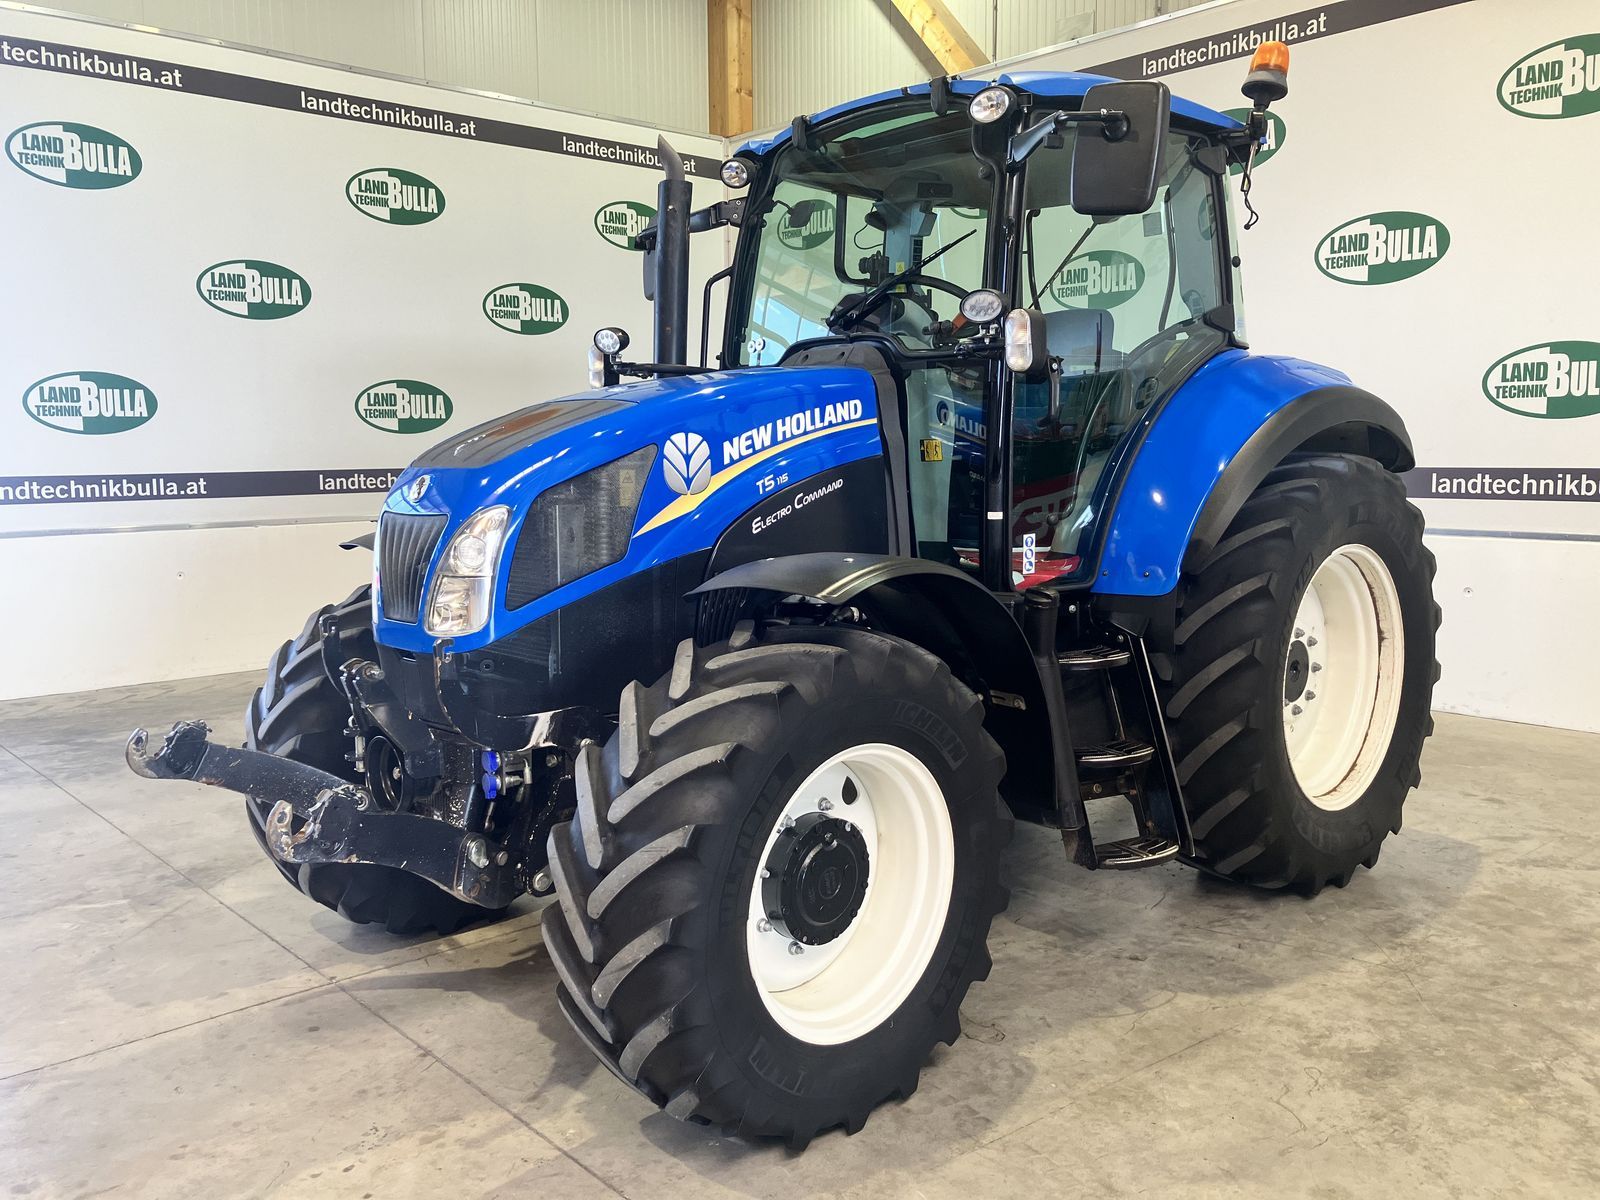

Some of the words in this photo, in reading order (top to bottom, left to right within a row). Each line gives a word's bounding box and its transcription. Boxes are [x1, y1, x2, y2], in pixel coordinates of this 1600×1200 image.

[1, 41, 182, 87] technikbulla.at
[1516, 60, 1563, 87] LAND
[1509, 83, 1563, 106] TECHNIK
[300, 91, 476, 136] landtechnikbulla.at
[22, 133, 64, 153] LAND
[17, 152, 65, 168] TECHNIK
[63, 131, 132, 176] BULLA
[358, 178, 388, 195] LAND
[388, 176, 438, 213] BULLA
[355, 194, 389, 208] TECHNIK
[603, 210, 627, 225] LAND
[601, 224, 627, 236] TECHNIK
[1330, 232, 1369, 254] LAND
[1369, 223, 1437, 265] BULLA
[1325, 253, 1368, 270] TECHNIK
[211, 272, 246, 289] LAND
[245, 268, 303, 305] BULLA
[1060, 268, 1088, 285] LAND
[1088, 260, 1136, 295] BULLA
[207, 289, 247, 302] TECHNIK
[493, 294, 519, 308] LAND
[1057, 285, 1088, 298] TECHNIK
[490, 309, 520, 320] TECHNIK
[519, 290, 562, 322] BULLA
[1501, 362, 1548, 382] LAND
[39, 386, 81, 403] LAND
[80, 380, 148, 417] BULLA
[367, 393, 397, 407] LAND
[1494, 384, 1548, 399] TECHNIK
[35, 405, 82, 417] TECHNIK
[397, 388, 446, 419] BULLA
[364, 409, 397, 419] TECHNIK
[723, 422, 772, 465] NEW
[776, 399, 862, 441] HOLLAND
[0, 478, 207, 500] ndtechnikbulla.at
[756, 474, 774, 494] T5
[776, 472, 788, 485] 115
[1431, 472, 1600, 496] landtechnikb
